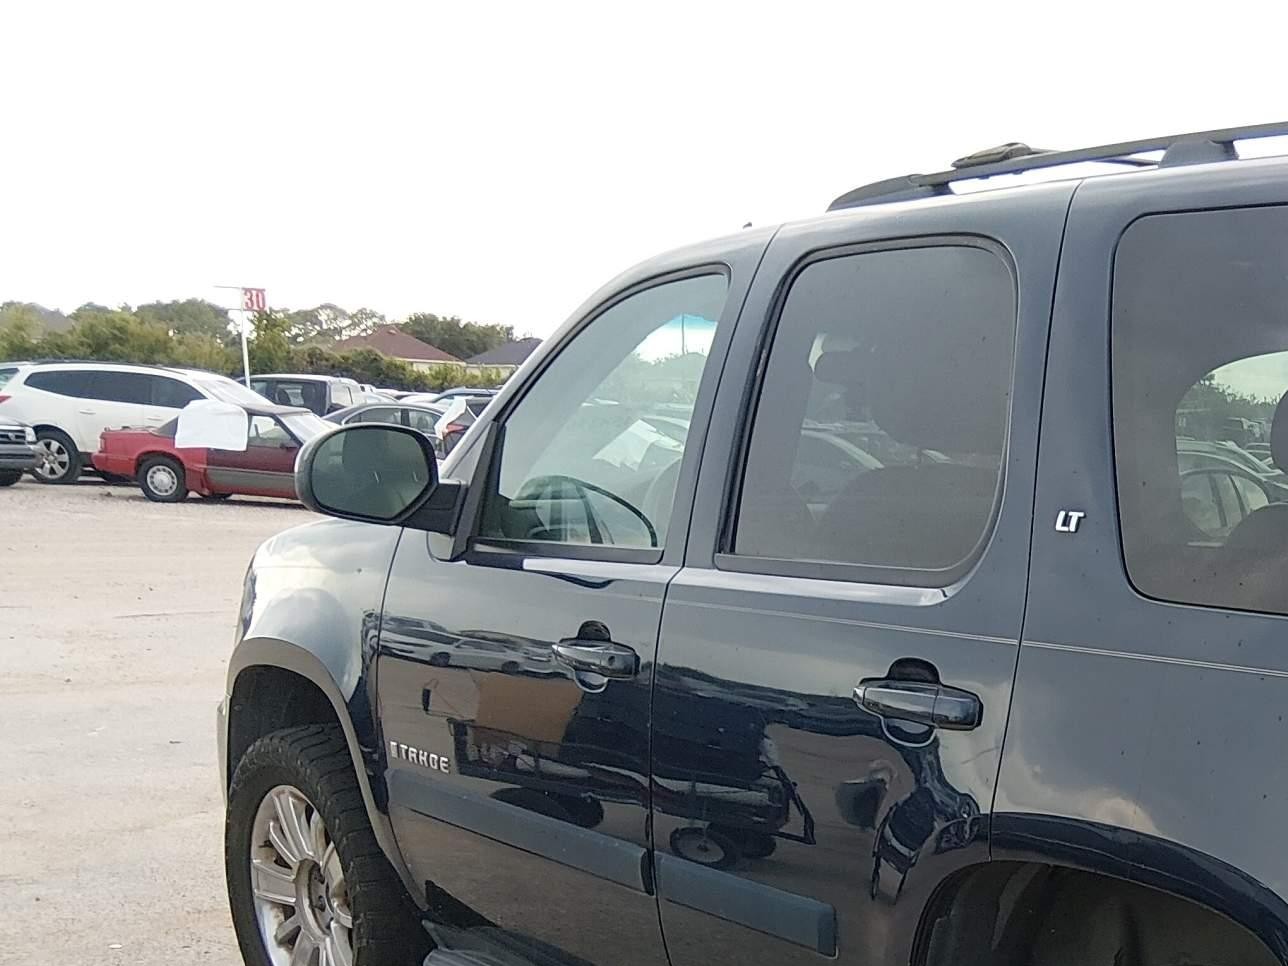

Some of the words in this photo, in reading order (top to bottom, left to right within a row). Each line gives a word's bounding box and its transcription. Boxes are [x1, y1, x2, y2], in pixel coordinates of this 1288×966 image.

[243, 288, 266, 310] 30
[1055, 510, 1085, 532] LT
[400, 743, 449, 773] TAHOE
